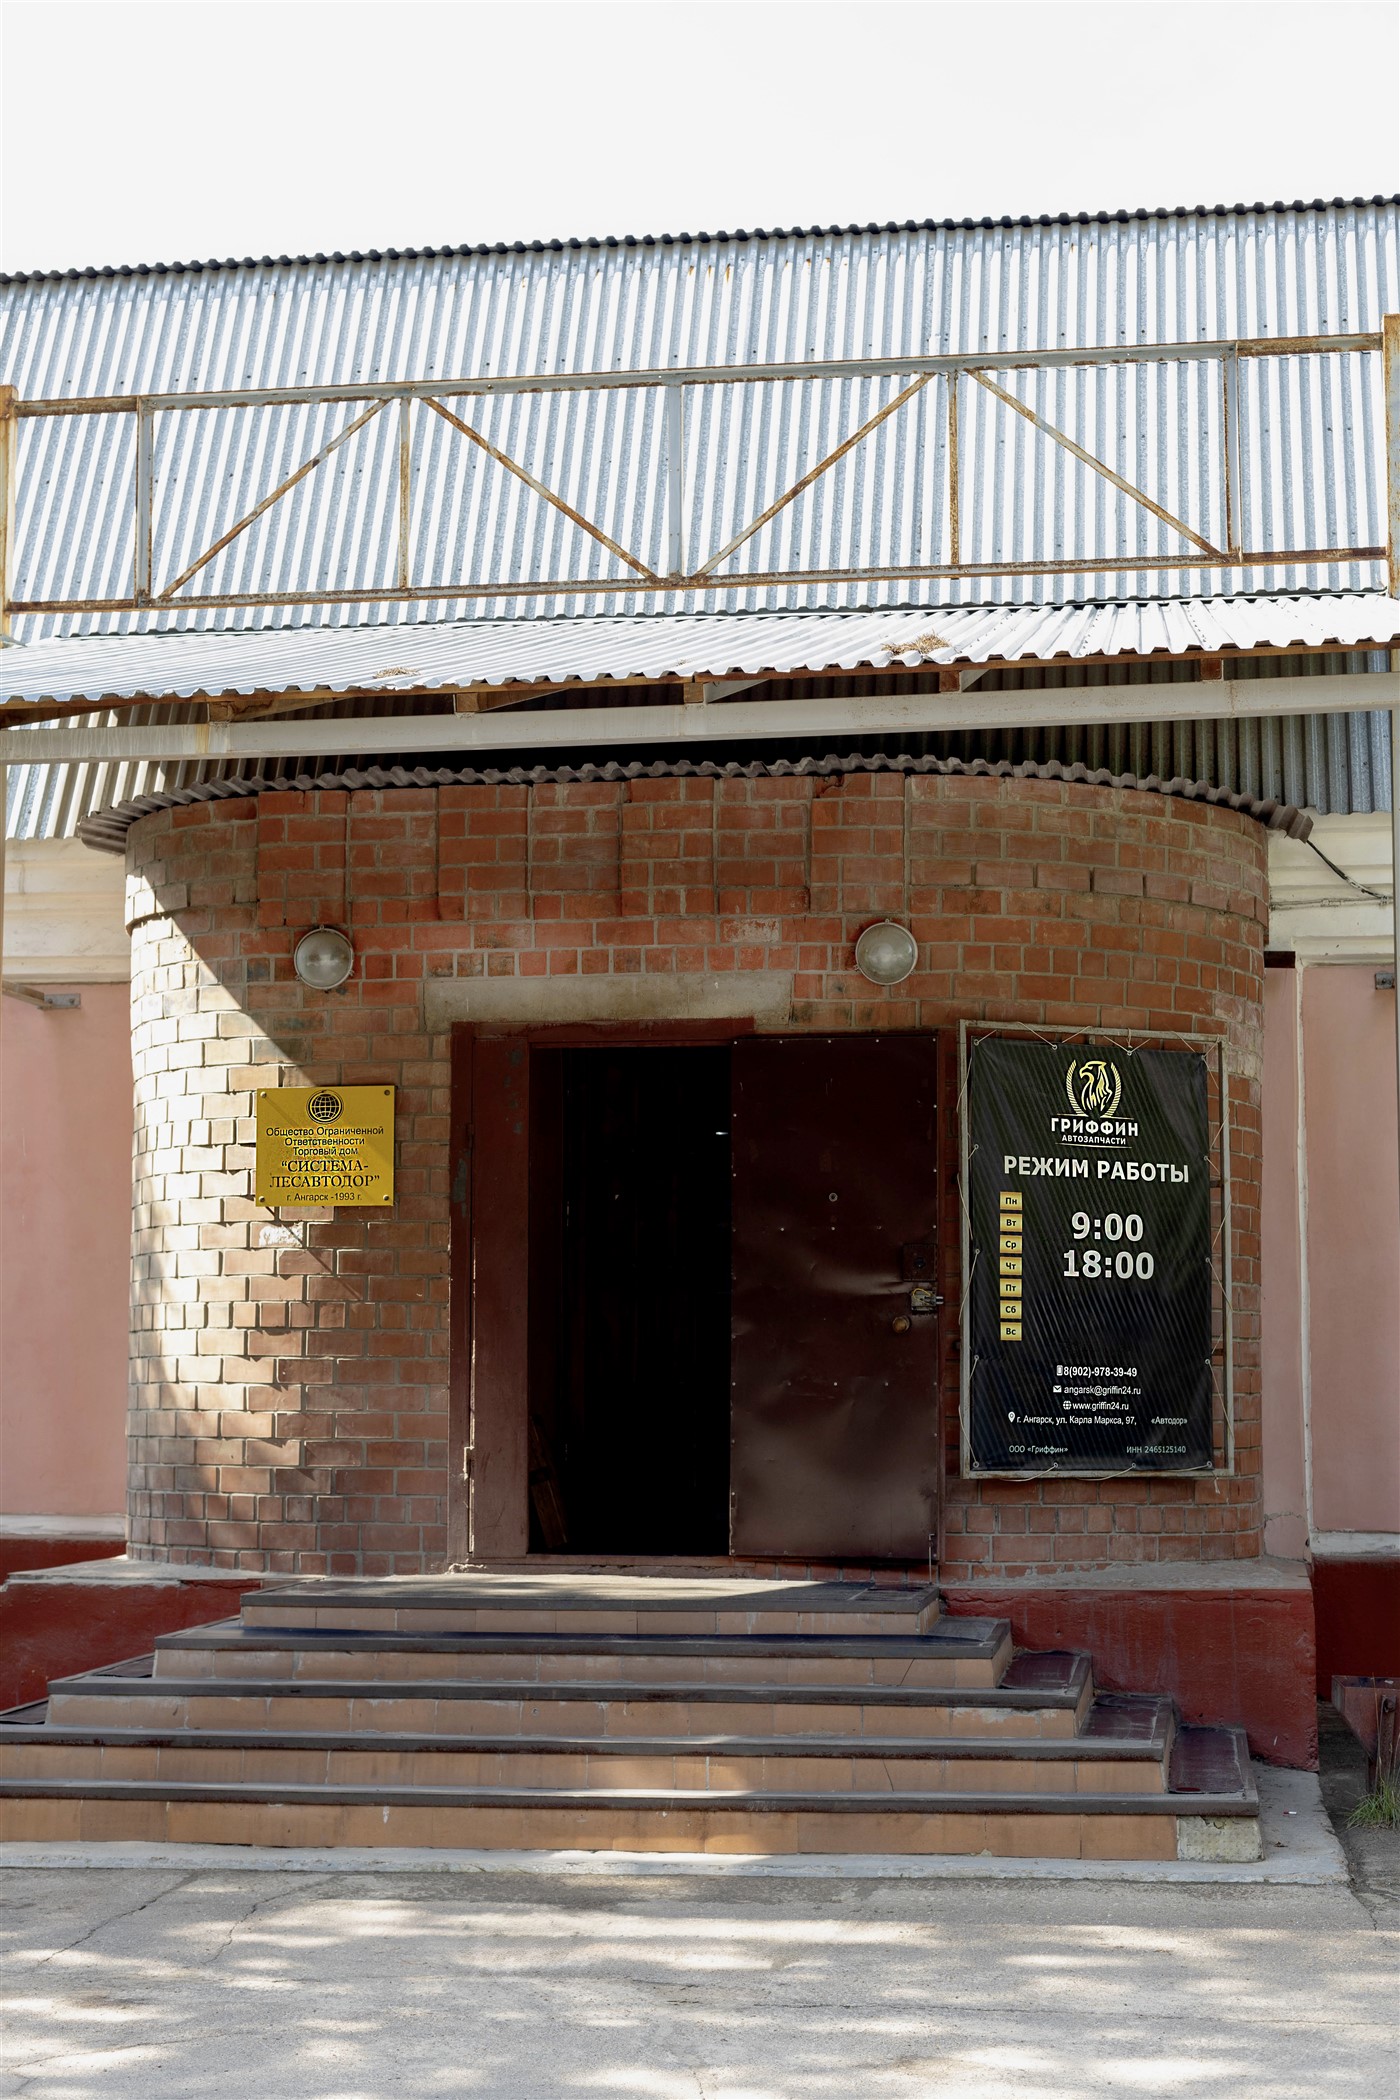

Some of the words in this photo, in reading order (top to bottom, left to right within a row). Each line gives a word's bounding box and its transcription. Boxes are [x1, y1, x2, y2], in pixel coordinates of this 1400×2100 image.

[266, 1127, 314, 1137] Общество
[317, 1126, 384, 1137] Ограниченной
[1050, 1117, 1139, 1137] ГРИФФИН
[284, 1137, 365, 1146] Ответственности
[1061, 1134, 1126, 1146] АВТОЗАПЧАСТИ
[293, 1147, 337, 1156] Торговый
[339, 1147, 358, 1156] дом
[1004, 1155, 1089, 1178] РЕЖИМ
[1097, 1160, 1189, 1183] РАБОТЫ
[294, 1192, 329, 1202] Ангарск
[1005, 1197, 1018, 1205] Пн
[1006, 1219, 1017, 1227] Вт
[1071, 1211, 1144, 1242] 9:00
[1005, 1241, 1017, 1250] Ср
[1005, 1262, 1017, 1270] Чт
[1063, 1249, 1155, 1280] 18:00
[1005, 1284, 1017, 1292] Пт
[1005, 1305, 1017, 1314] Сб
[1005, 1327, 1017, 1335] Вс
[1063, 1366, 1138, 1378] 8(902)-978-39-49
[1063, 1385, 1141, 1396] angarsk@griffin24.ru
[1072, 1401, 1130, 1411] www.griffin24.ru
[1023, 1415, 1055, 1425] Ангарск,
[1055, 1416, 1067, 1425] ул.
[1069, 1415, 1093, 1425] Карла
[1094, 1416, 1124, 1426] Маркса,
[1125, 1416, 1137, 1426] 97,
[1150, 1416, 1188, 1426] «Автодор»
[1008, 1445, 1026, 1453] ООО
[1027, 1445, 1069, 1455] «Гриффин»
[1126, 1445, 1143, 1453] ИНН
[1144, 1445, 1187, 1454] 2465125140
